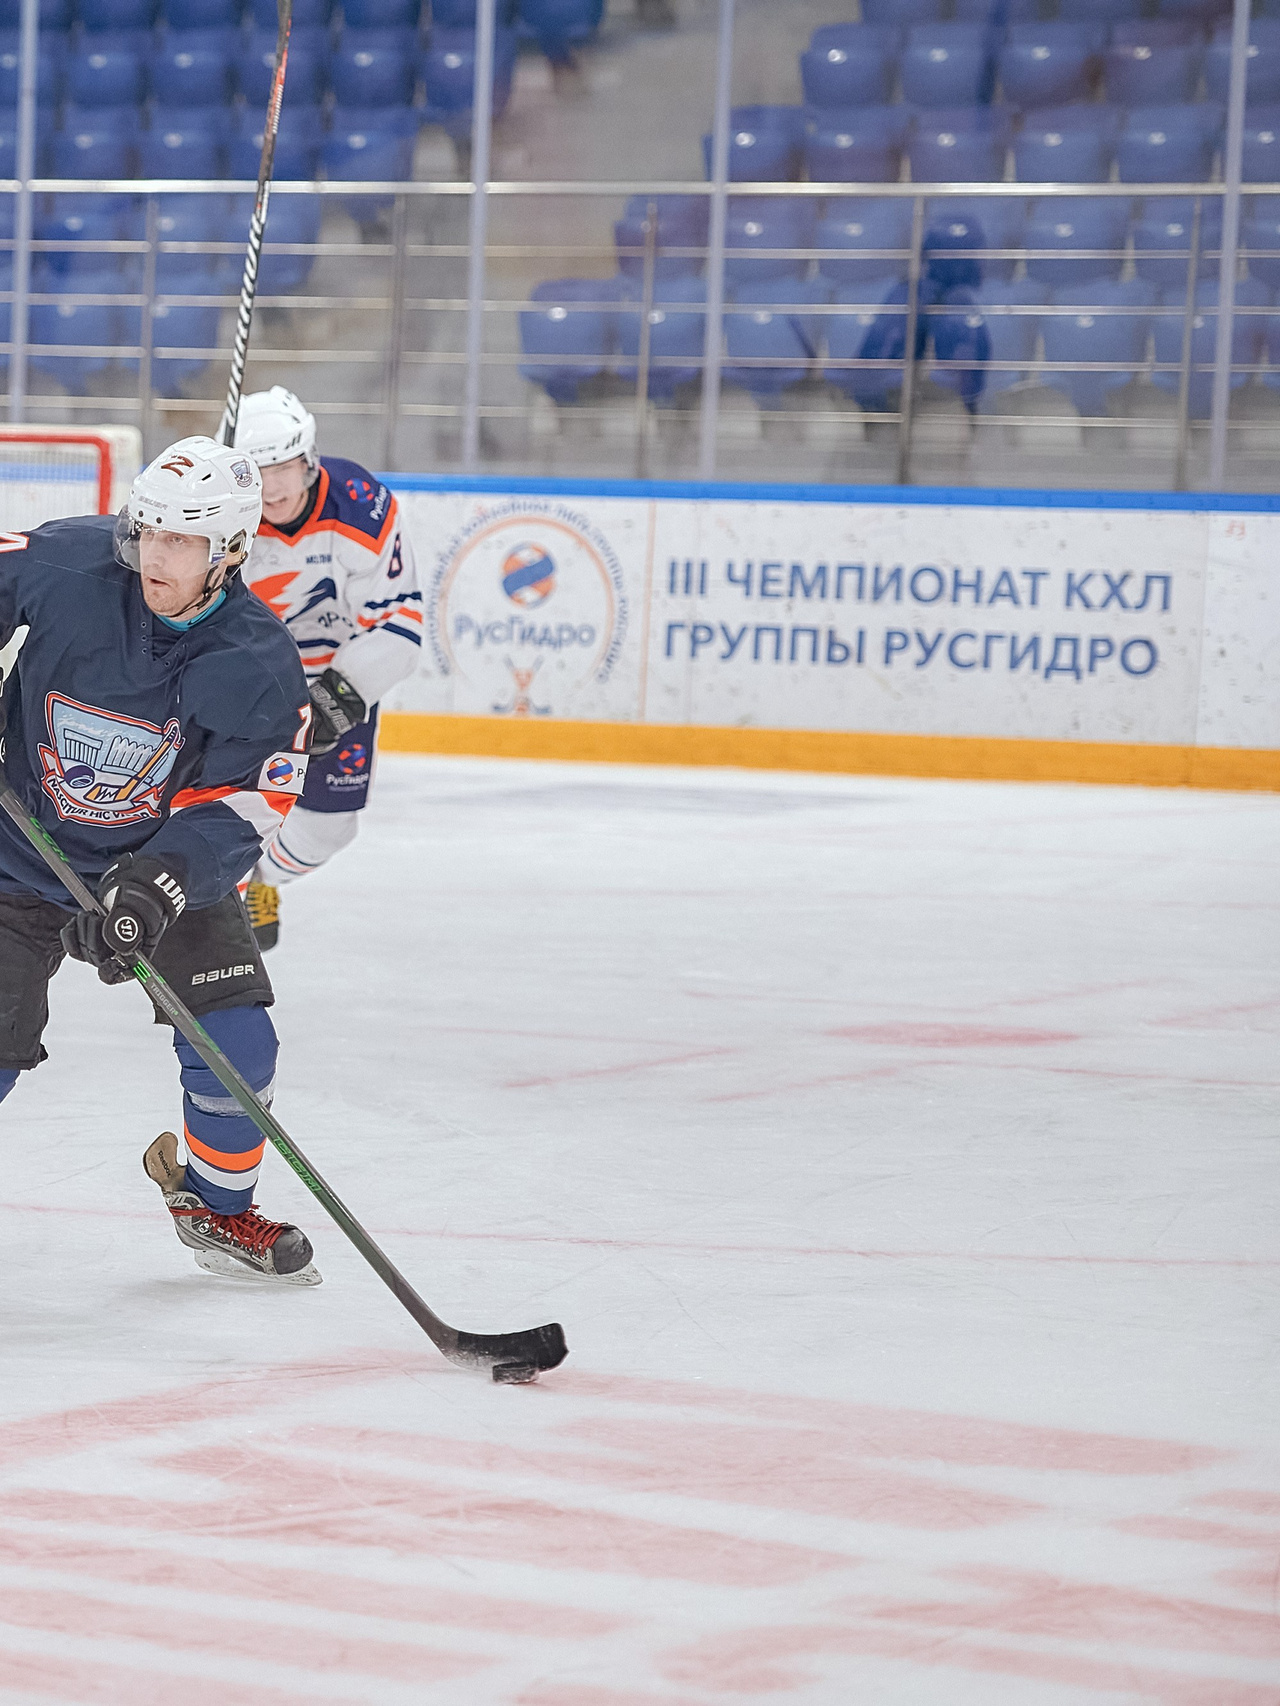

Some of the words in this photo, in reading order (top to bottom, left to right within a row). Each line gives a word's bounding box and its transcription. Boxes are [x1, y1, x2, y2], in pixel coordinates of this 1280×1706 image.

[726, 560, 1050, 606] ЧЕМПИОНАТ
[1065, 572, 1172, 610] КХЛ
[454, 614, 596, 650] РусГидро
[666, 623, 866, 664] ГРУППЫ
[883, 630, 1159, 681] РУСГИДРО
[292, 703, 315, 751] 7
[47, 778, 89, 815] NASCITUR
[89, 810, 111, 820] HIC
[153, 872, 186, 917] WA
[191, 964, 256, 986] BAUER
